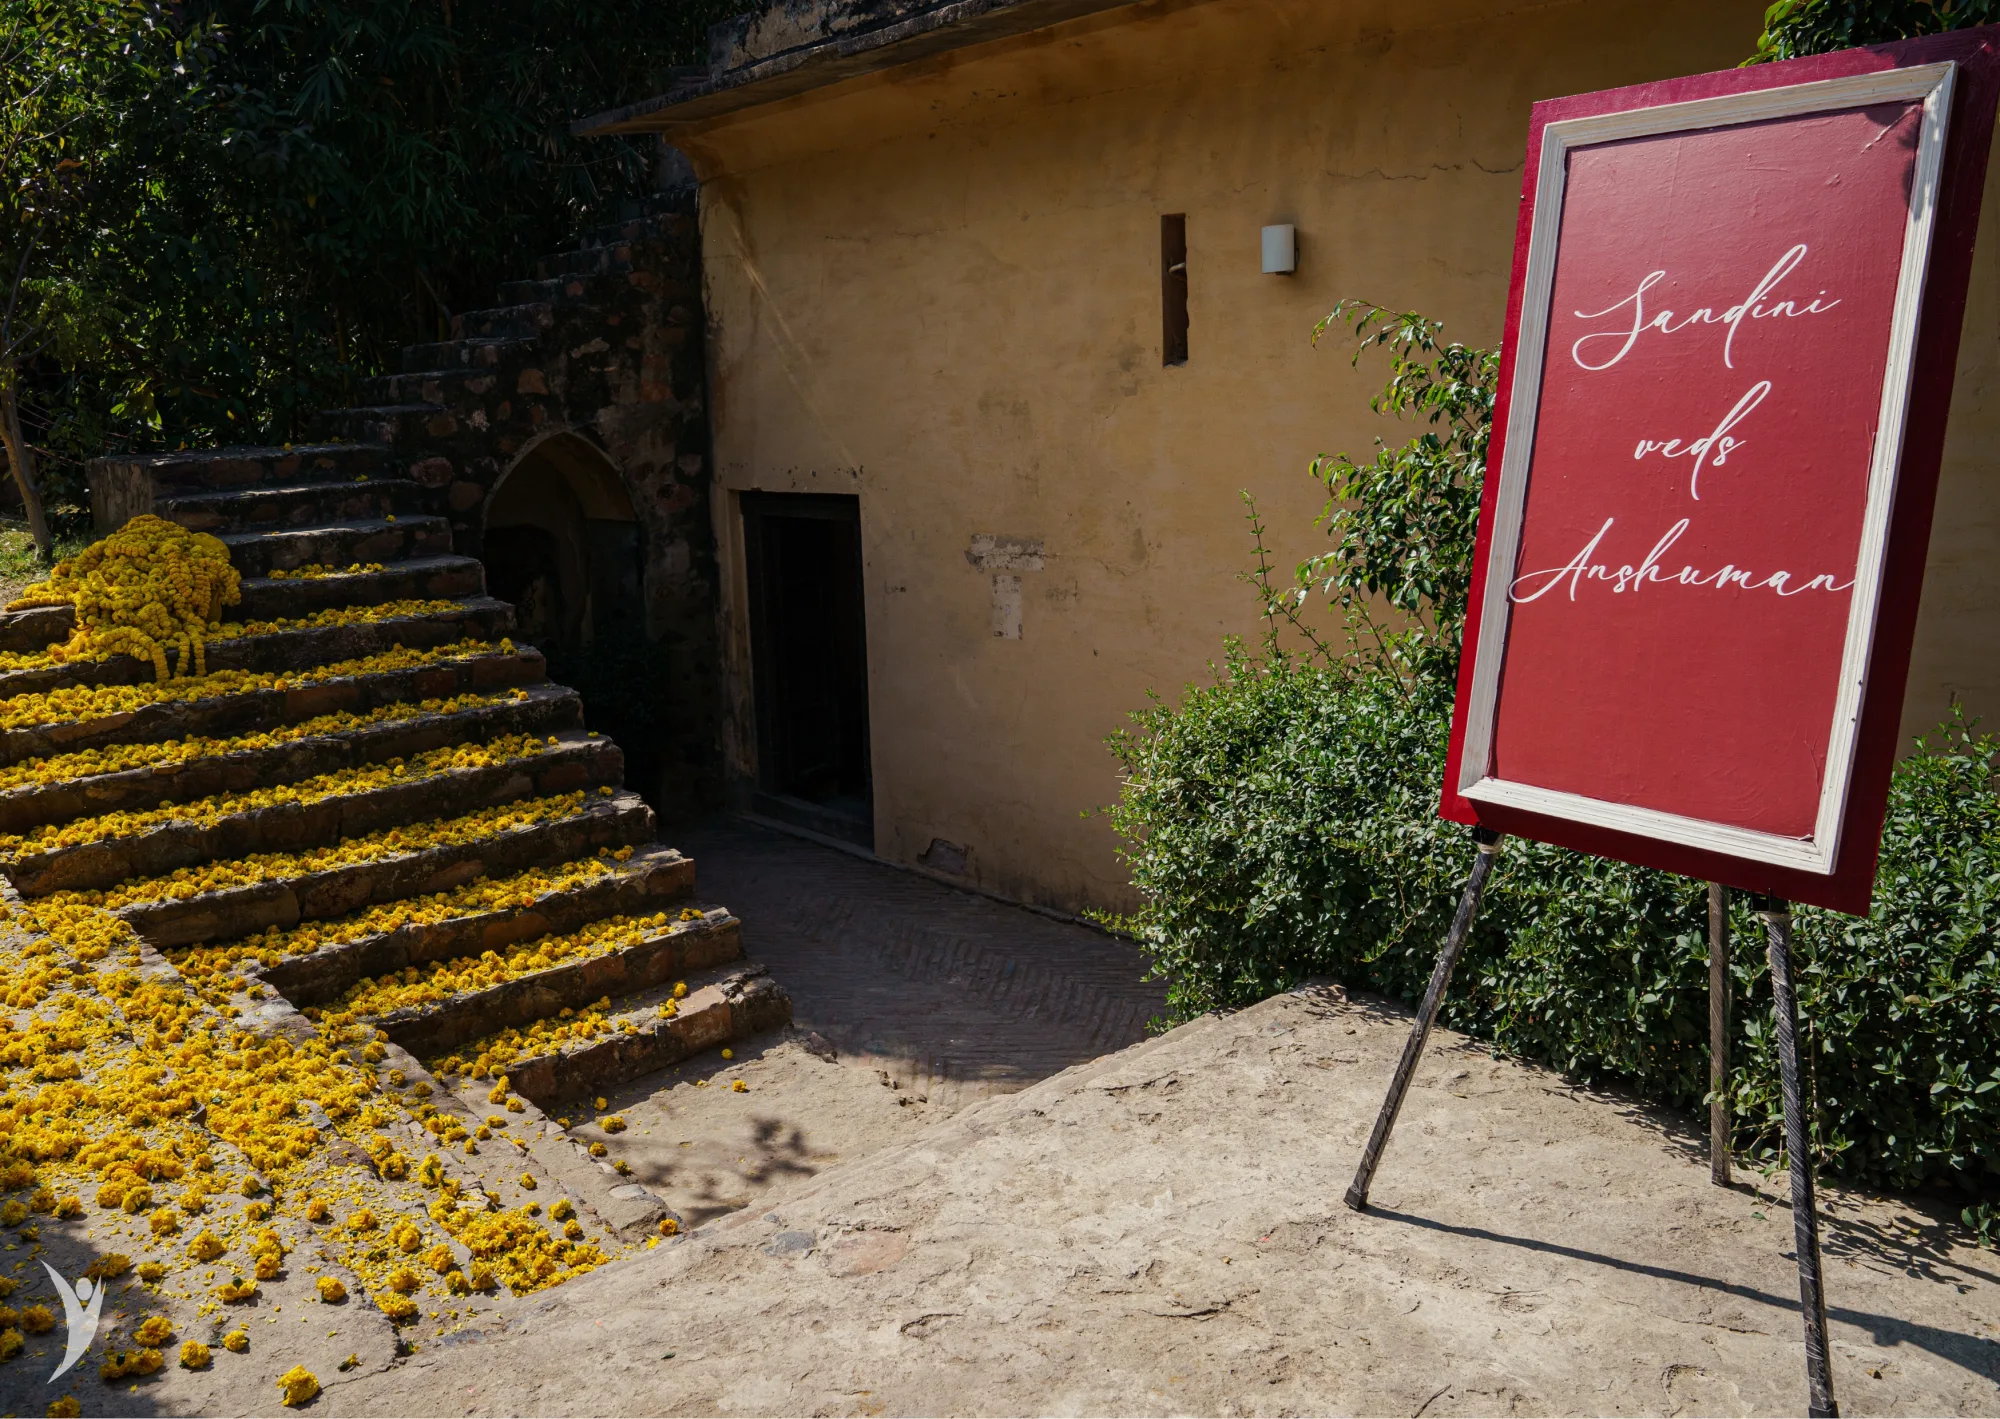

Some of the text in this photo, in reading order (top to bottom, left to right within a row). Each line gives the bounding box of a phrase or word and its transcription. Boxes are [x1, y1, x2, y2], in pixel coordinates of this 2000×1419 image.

[1572, 244, 1842, 370] Sandini
[1634, 380, 1772, 500] weds
[1508, 518, 1855, 603] Anshuman
